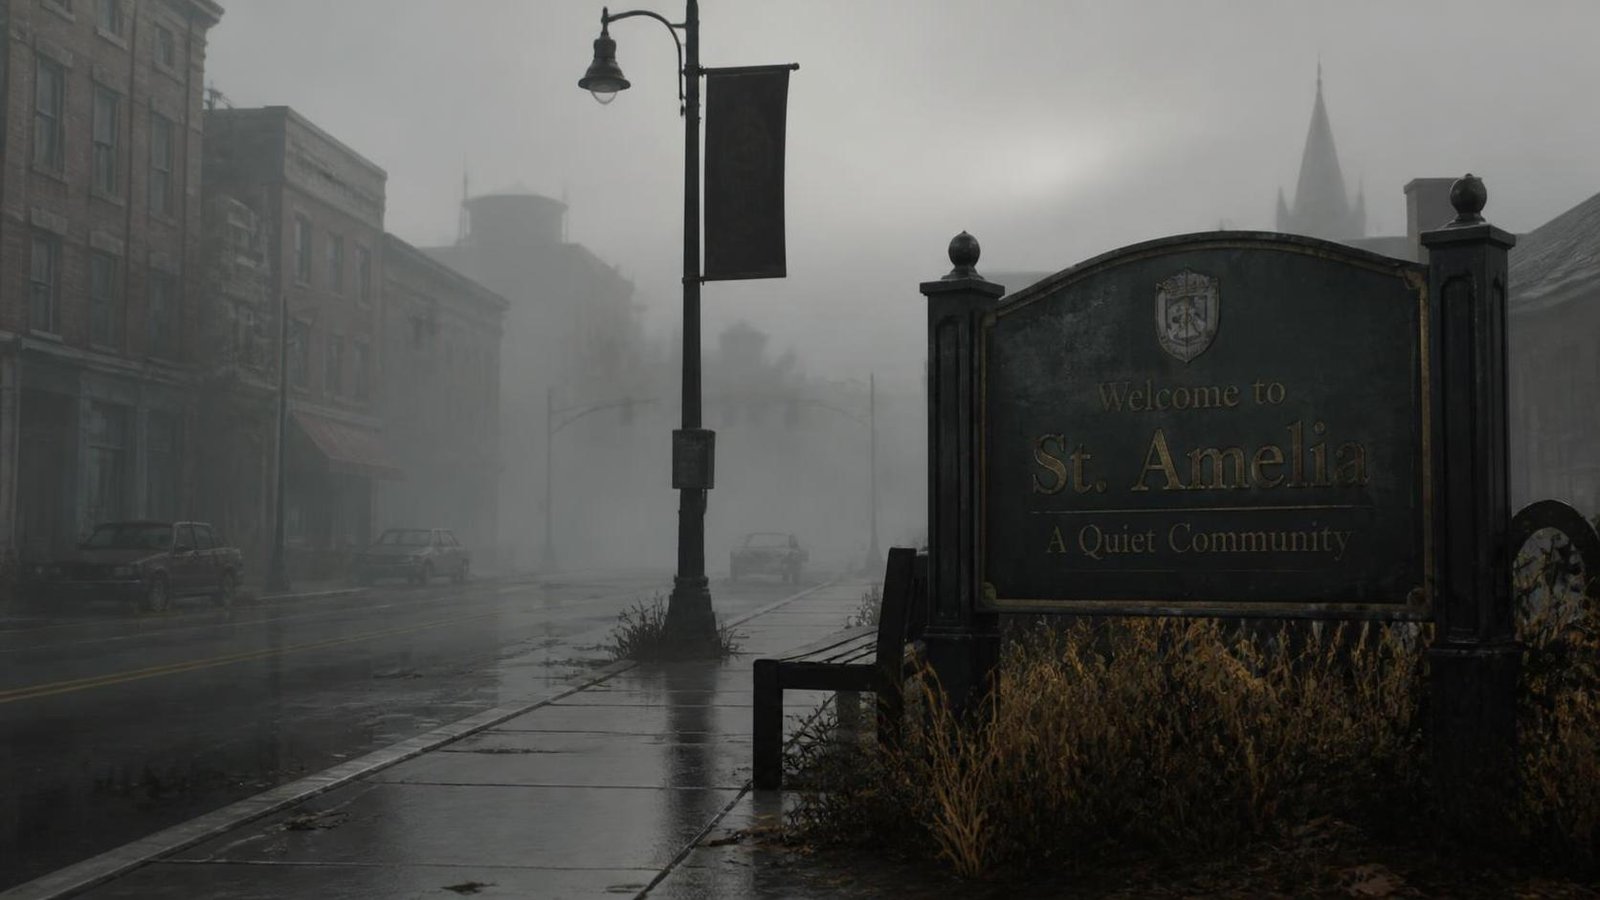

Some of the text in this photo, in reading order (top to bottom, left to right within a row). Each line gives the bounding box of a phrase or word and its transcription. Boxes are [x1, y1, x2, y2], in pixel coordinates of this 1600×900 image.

[1099, 378, 1286, 413] Welcome to
[1031, 421, 1371, 496] St. Amelia
[1047, 521, 1353, 561] A Quiet Community
